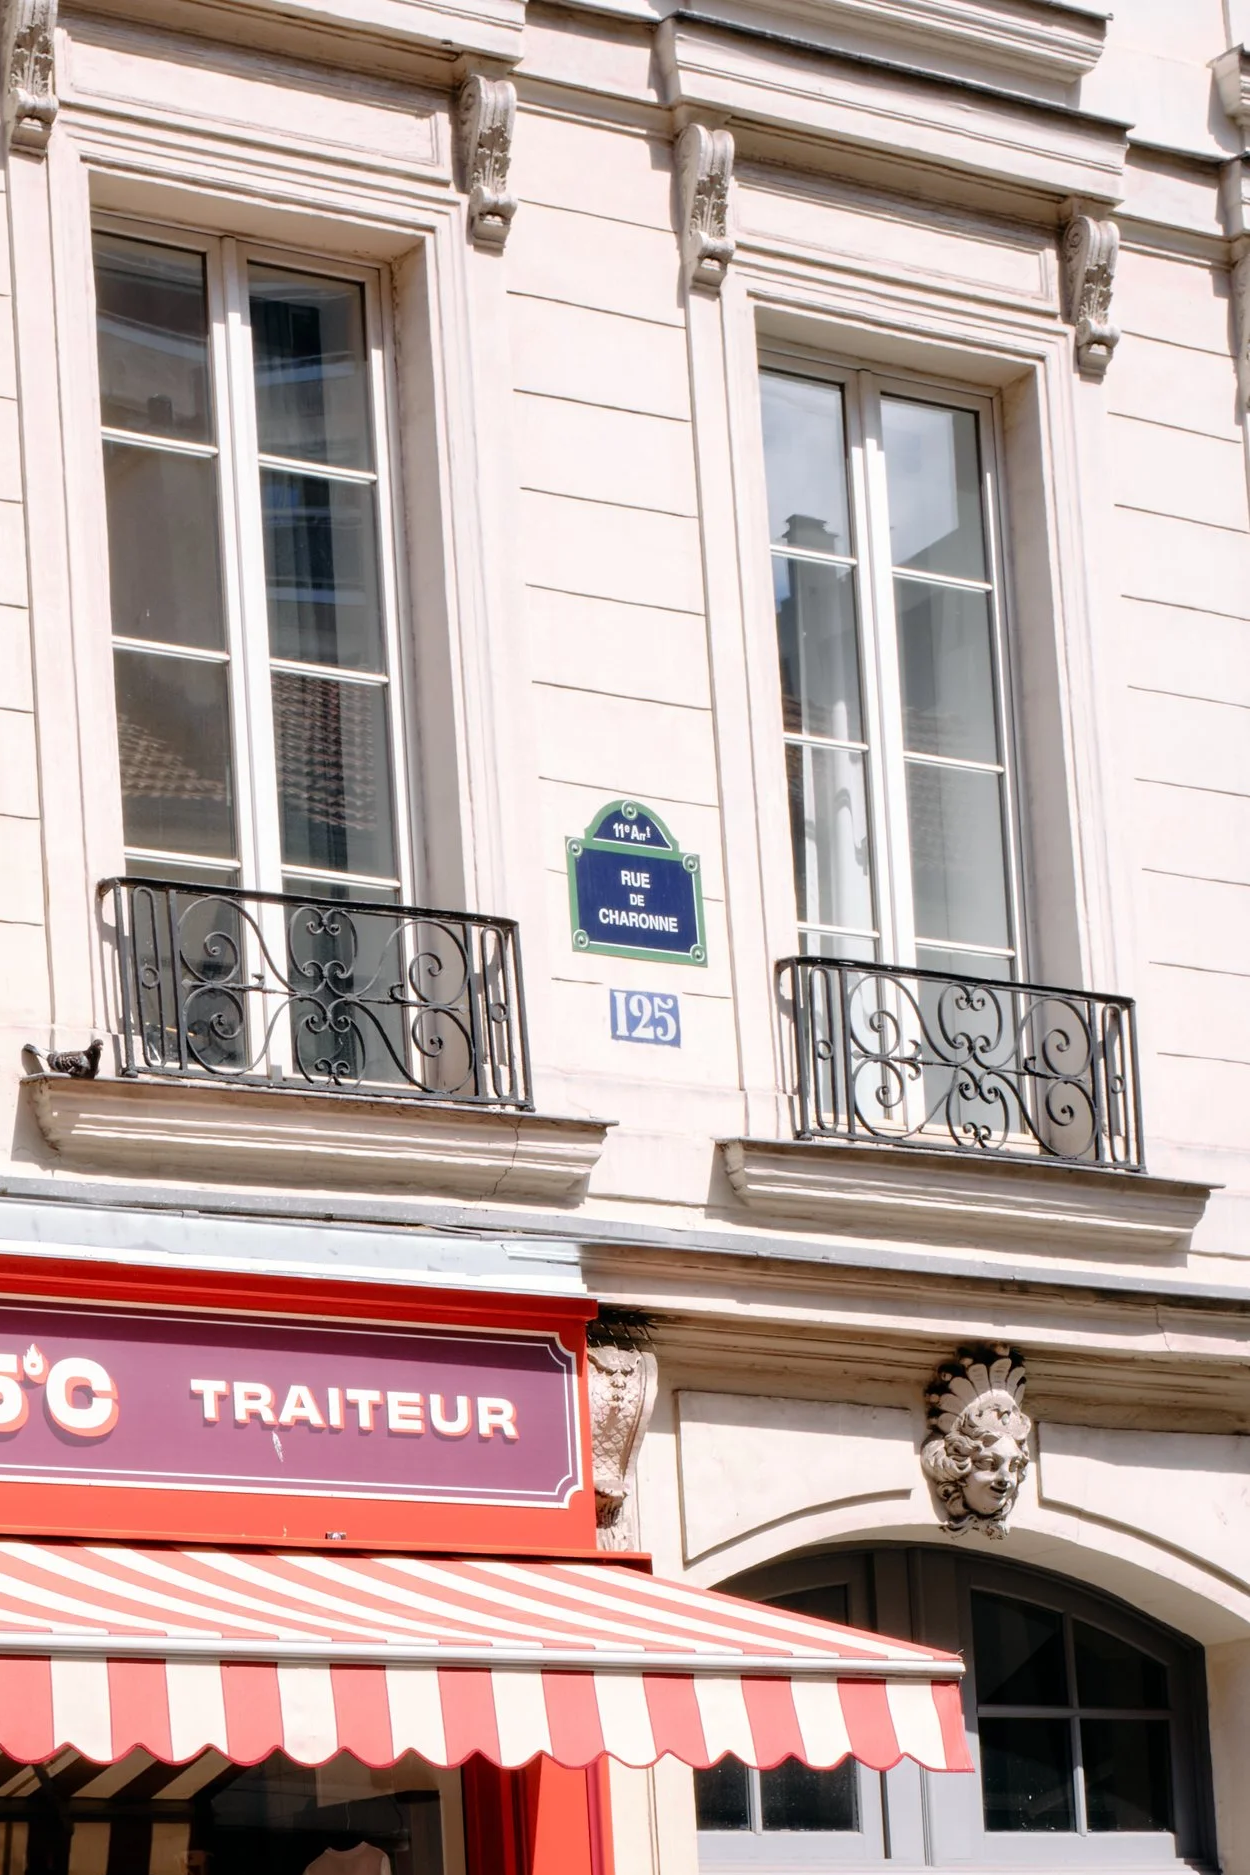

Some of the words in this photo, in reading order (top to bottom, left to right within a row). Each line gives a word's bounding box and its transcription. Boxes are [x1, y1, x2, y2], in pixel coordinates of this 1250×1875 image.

[620, 870, 651, 889] RUE
[629, 893, 645, 907] DE
[598, 908, 679, 933] CHARONNE
[613, 991, 677, 1042] 125
[190, 1377, 521, 1440] TRAITEUR
